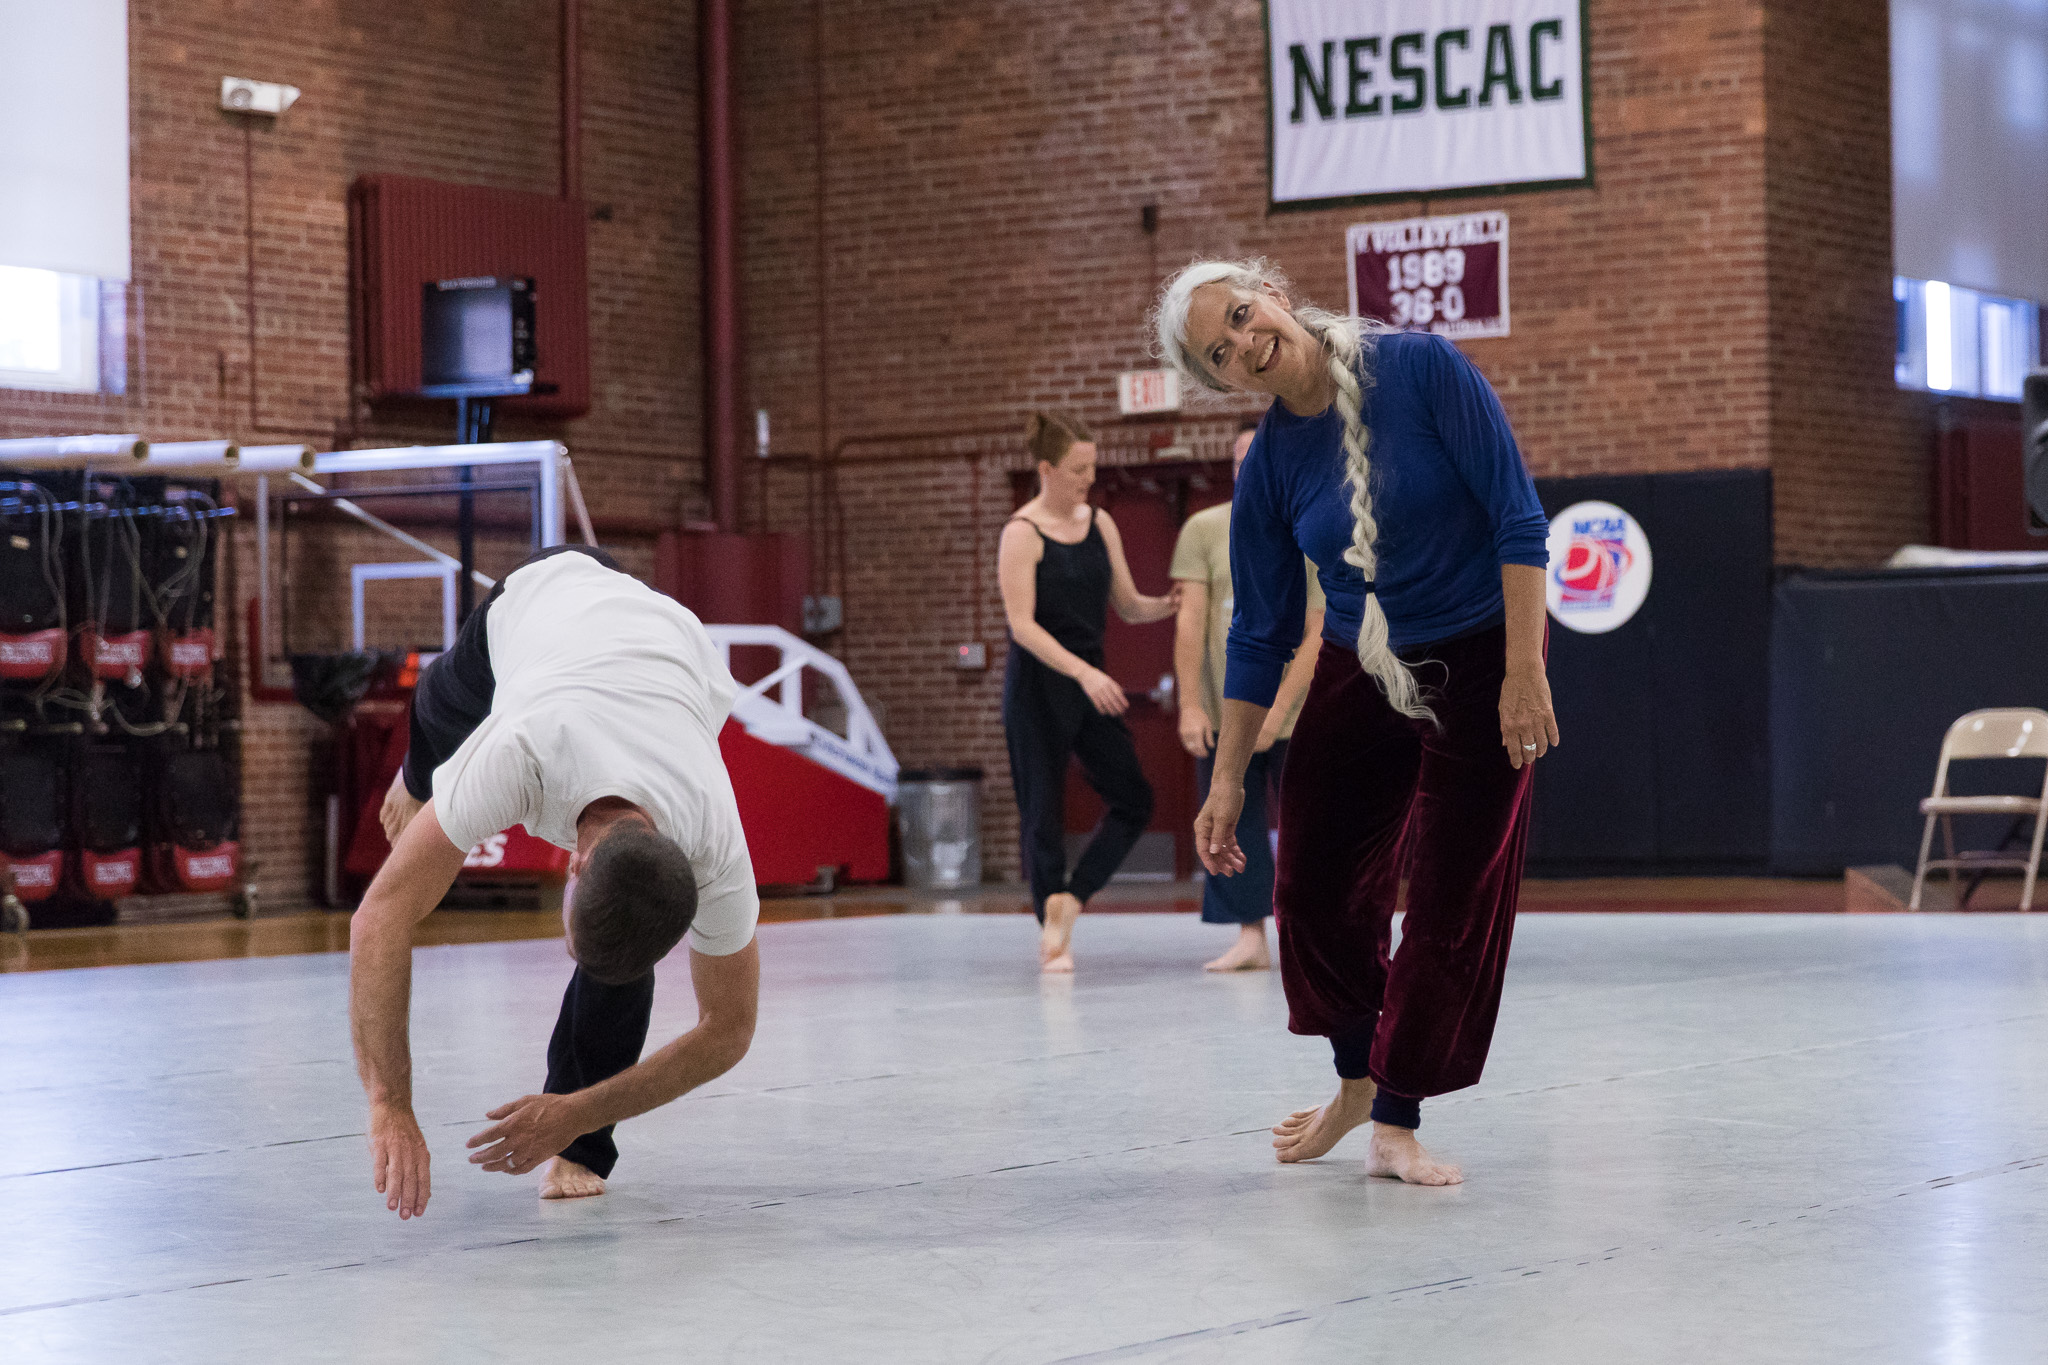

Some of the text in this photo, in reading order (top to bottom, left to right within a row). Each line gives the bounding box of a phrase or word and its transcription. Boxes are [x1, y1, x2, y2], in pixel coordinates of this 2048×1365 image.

[1288, 18, 1564, 125] NESCAC
[1387, 248, 1466, 291] 1989
[1389, 285, 1466, 326] 36-0
[1129, 372, 1167, 411] EXIT
